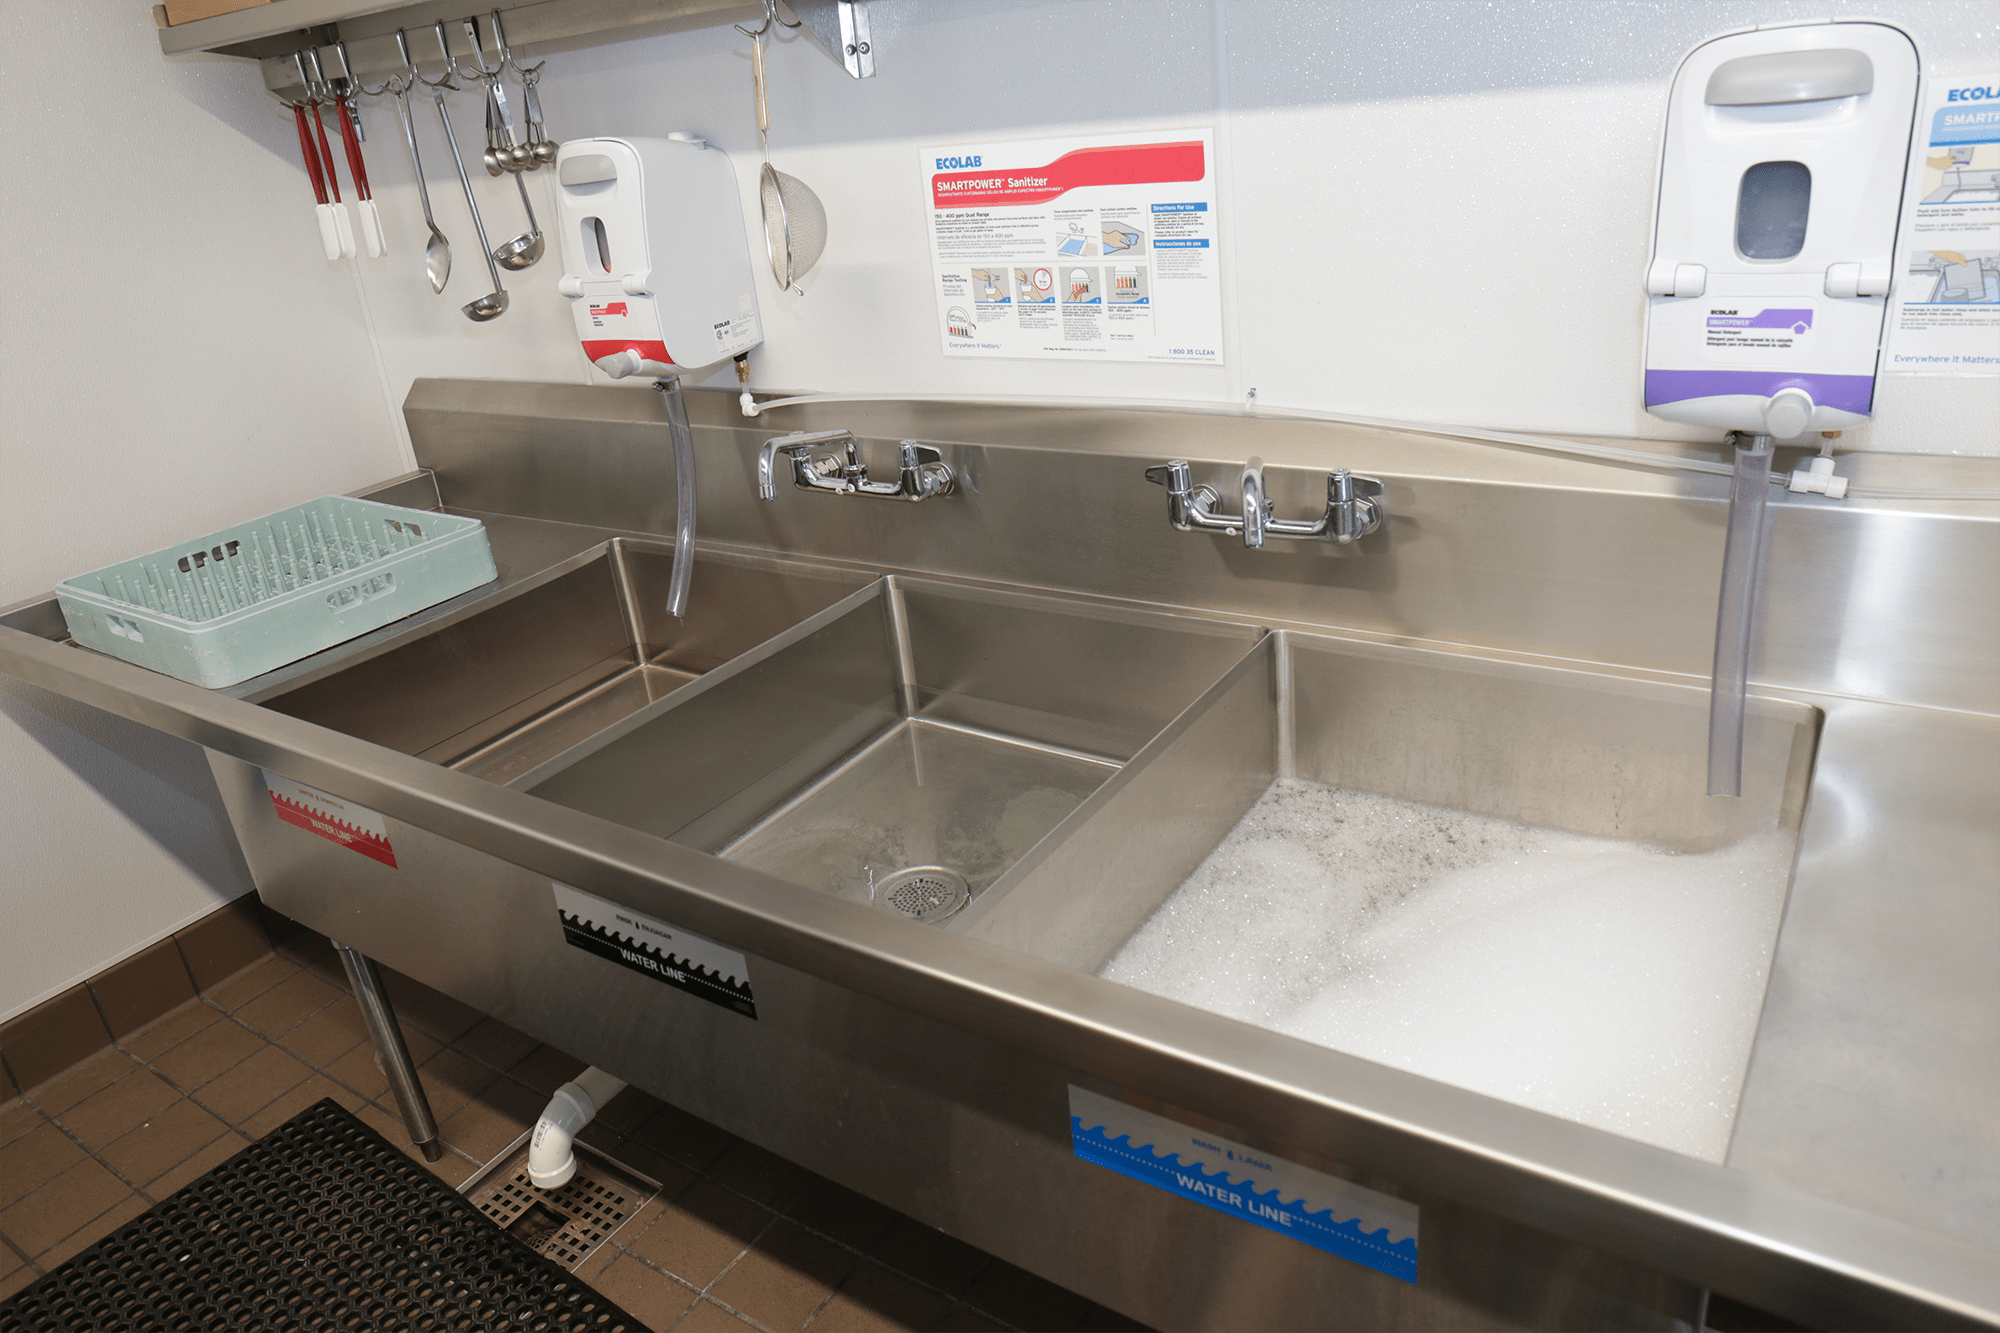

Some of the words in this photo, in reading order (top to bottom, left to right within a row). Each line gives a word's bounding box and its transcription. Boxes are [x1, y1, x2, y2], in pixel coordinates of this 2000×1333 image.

[1008, 176, 1048, 188] Sanitizer
[1894, 354, 1950, 364] Everywhere
[1952, 355, 1959, 363] It
[310, 818, 336, 836] WATER
[335, 828, 353, 842] LINE
[616, 914, 633, 927] RINSE
[641, 924, 672, 940] ENJUAGAR
[620, 948, 659, 972] WATER
[660, 964, 686, 984] LINE
[1191, 1137, 1221, 1154] WASH
[1175, 1172, 1242, 1209] WATER
[1247, 1199, 1292, 1228] LINE
